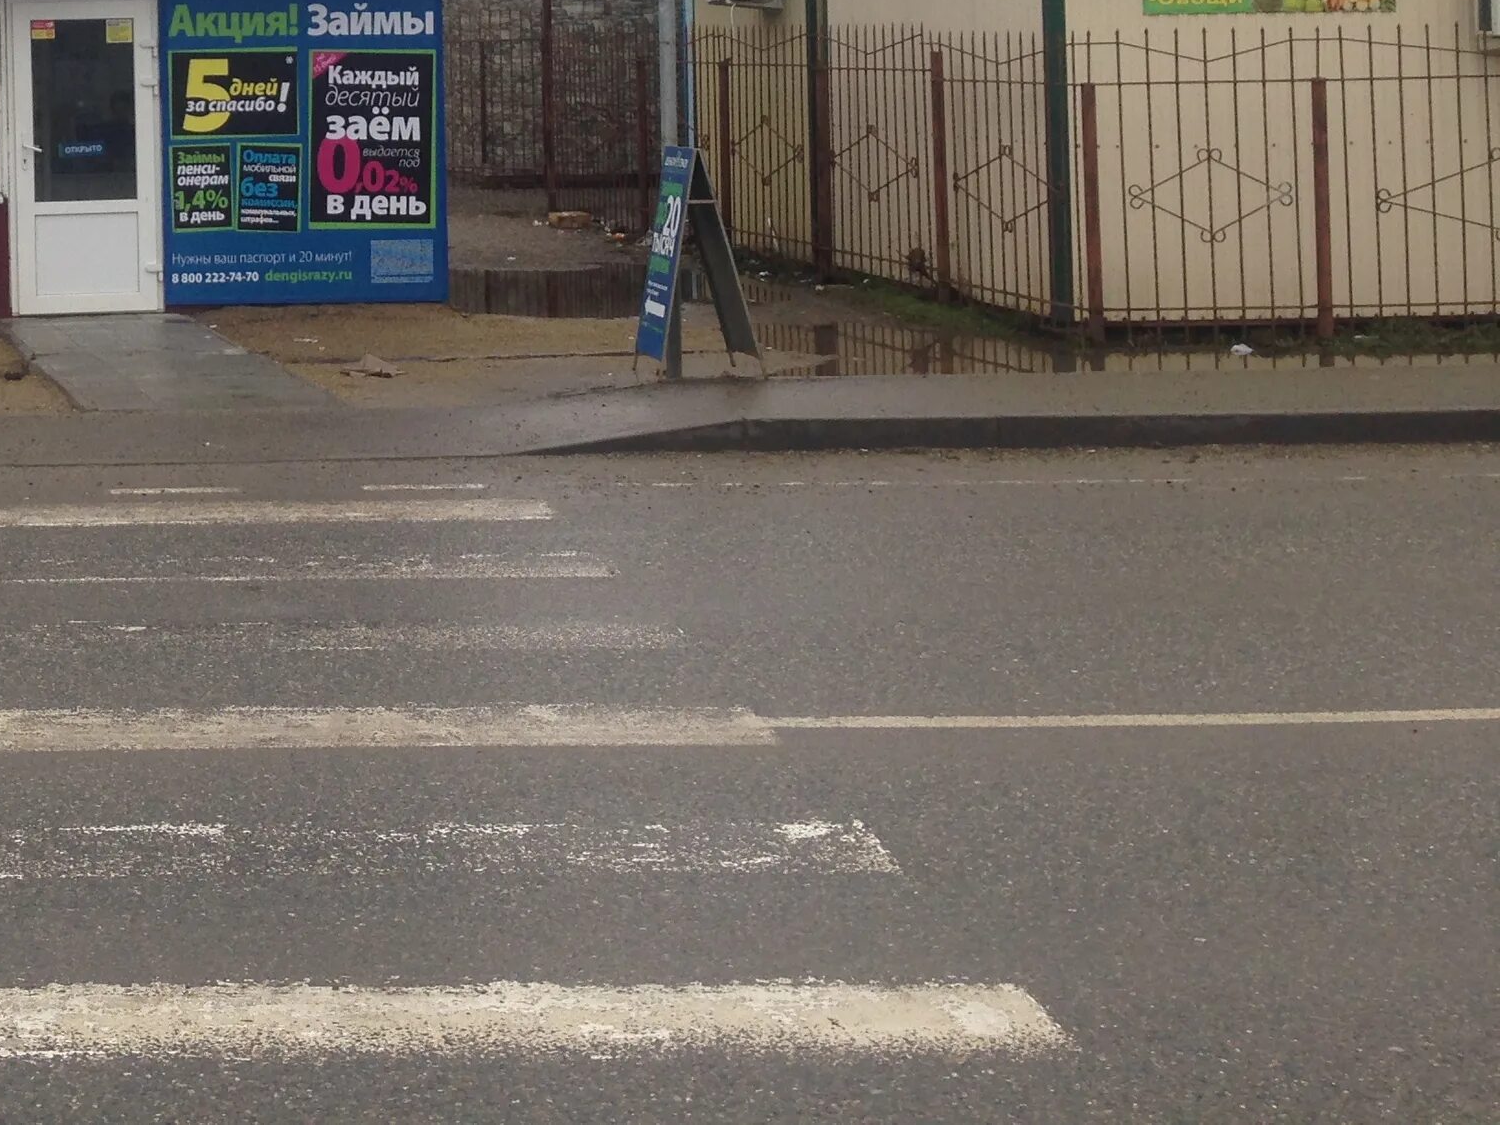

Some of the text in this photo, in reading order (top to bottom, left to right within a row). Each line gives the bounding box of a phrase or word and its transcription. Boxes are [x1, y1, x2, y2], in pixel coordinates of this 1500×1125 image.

[168, 1, 435, 44] Акция! Займы
[327, 65, 420, 89] Каждый
[183, 58, 279, 133] 5 дней
[325, 84, 420, 107] десятый
[186, 100, 206, 113] за
[325, 106, 421, 141] заём
[177, 151, 225, 164] Займы
[242, 150, 297, 164] Оплата
[362, 145, 421, 158] выдается
[177, 164, 220, 176] пенси-
[242, 162, 297, 174] мобильной
[399, 158, 421, 169] под
[177, 175, 229, 189] онерам
[268, 174, 297, 183] связи
[241, 177, 279, 197] без
[175, 189, 230, 212] 1,4%
[326, 195, 427, 221] в день
[179, 210, 225, 224] в день
[172, 250, 353, 267] Нужны ваш паспорт и 20 минут!
[171, 271, 260, 284] 8 800 222-74-70
[265, 269, 353, 284] dengisrazy.ru
